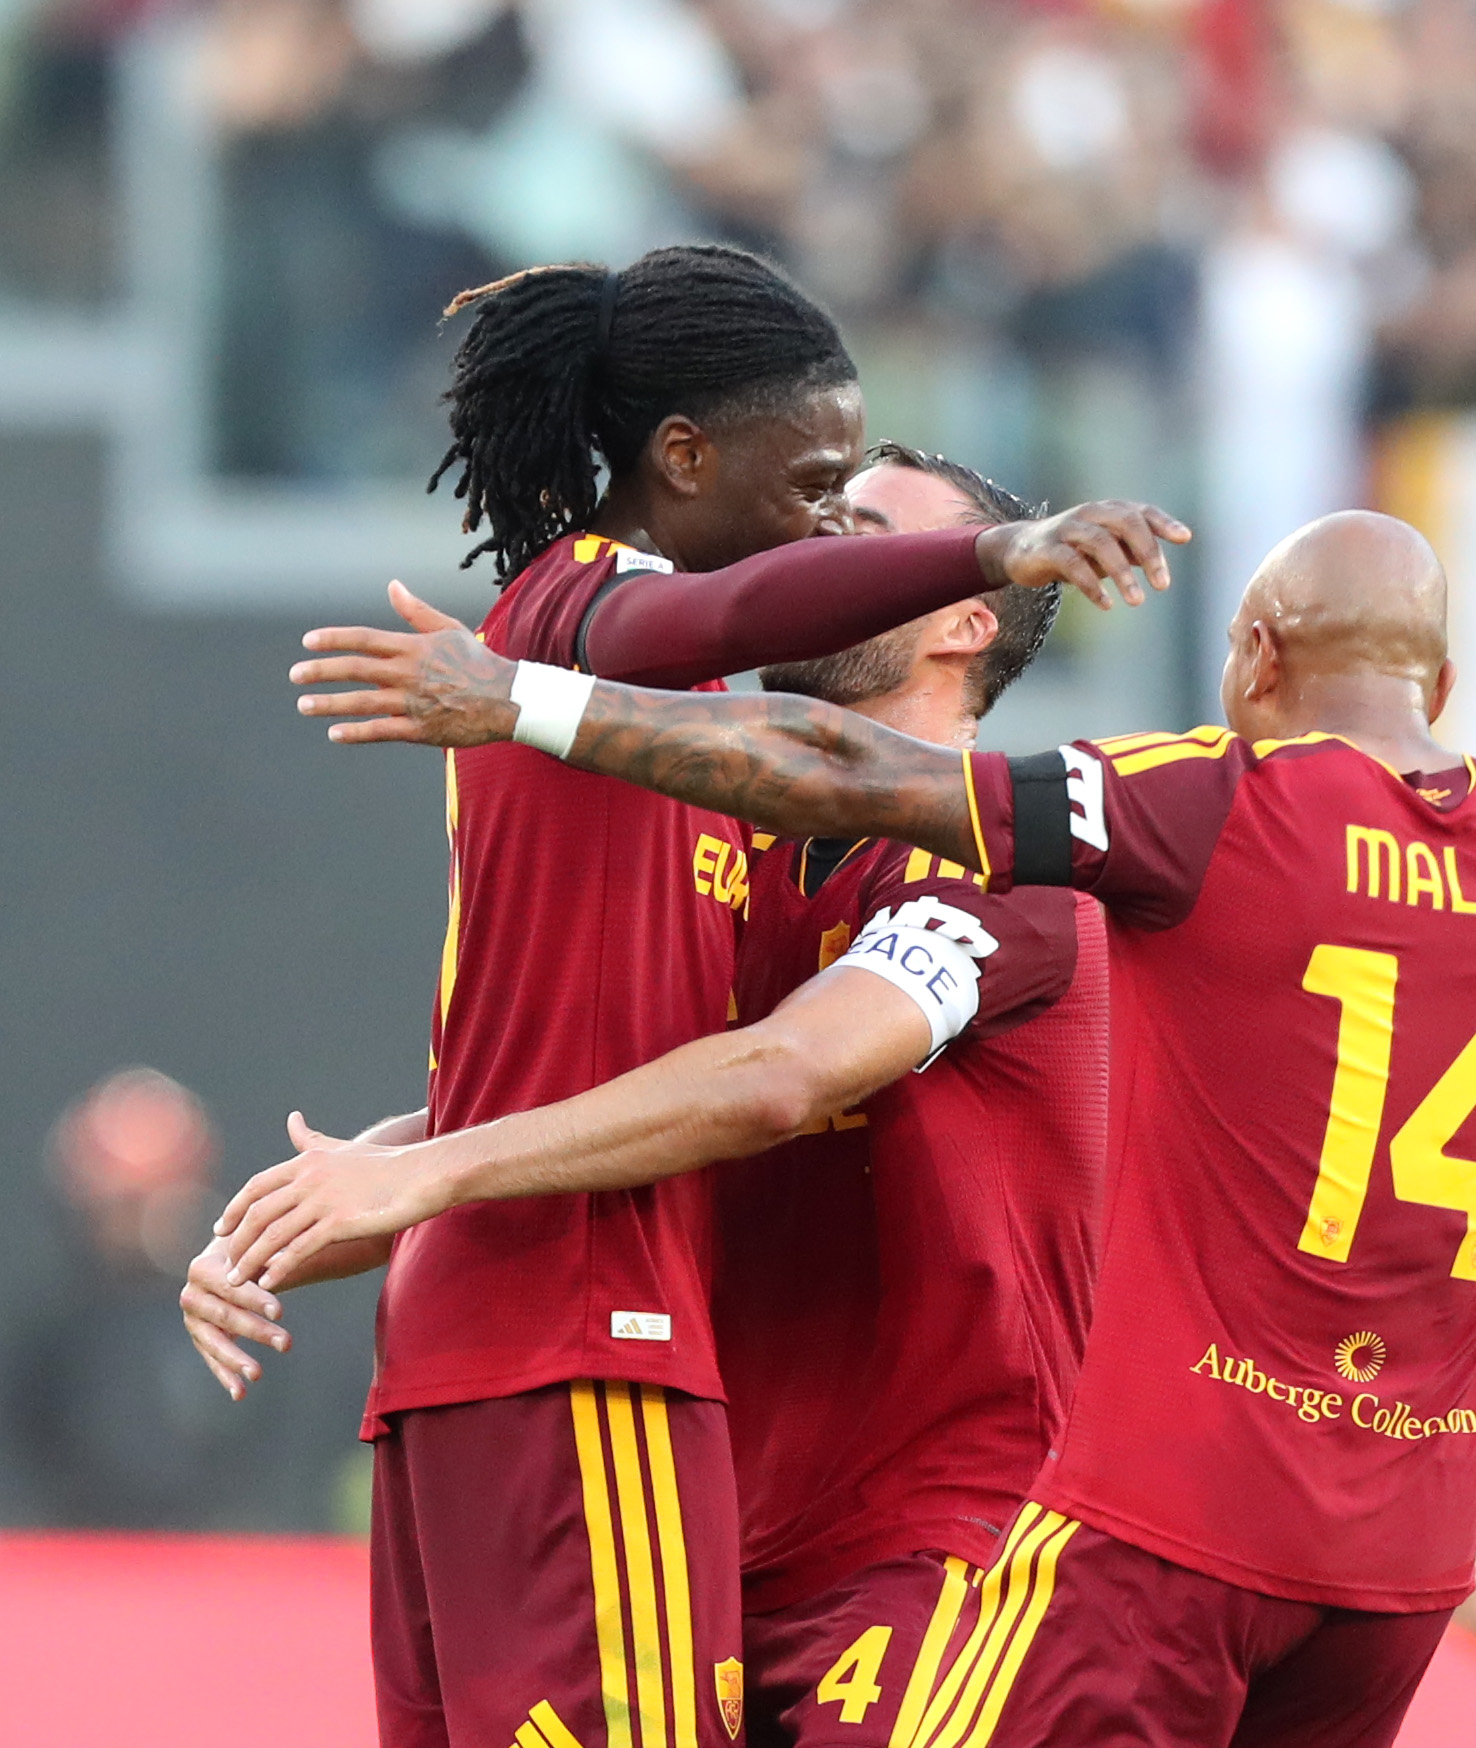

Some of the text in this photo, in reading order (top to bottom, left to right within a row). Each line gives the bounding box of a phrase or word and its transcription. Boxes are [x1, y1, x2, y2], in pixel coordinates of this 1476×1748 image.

[658, 562, 664, 571] A
[1189, 1342, 1344, 1423] Auberge
[816, 1625, 894, 1725] 4
